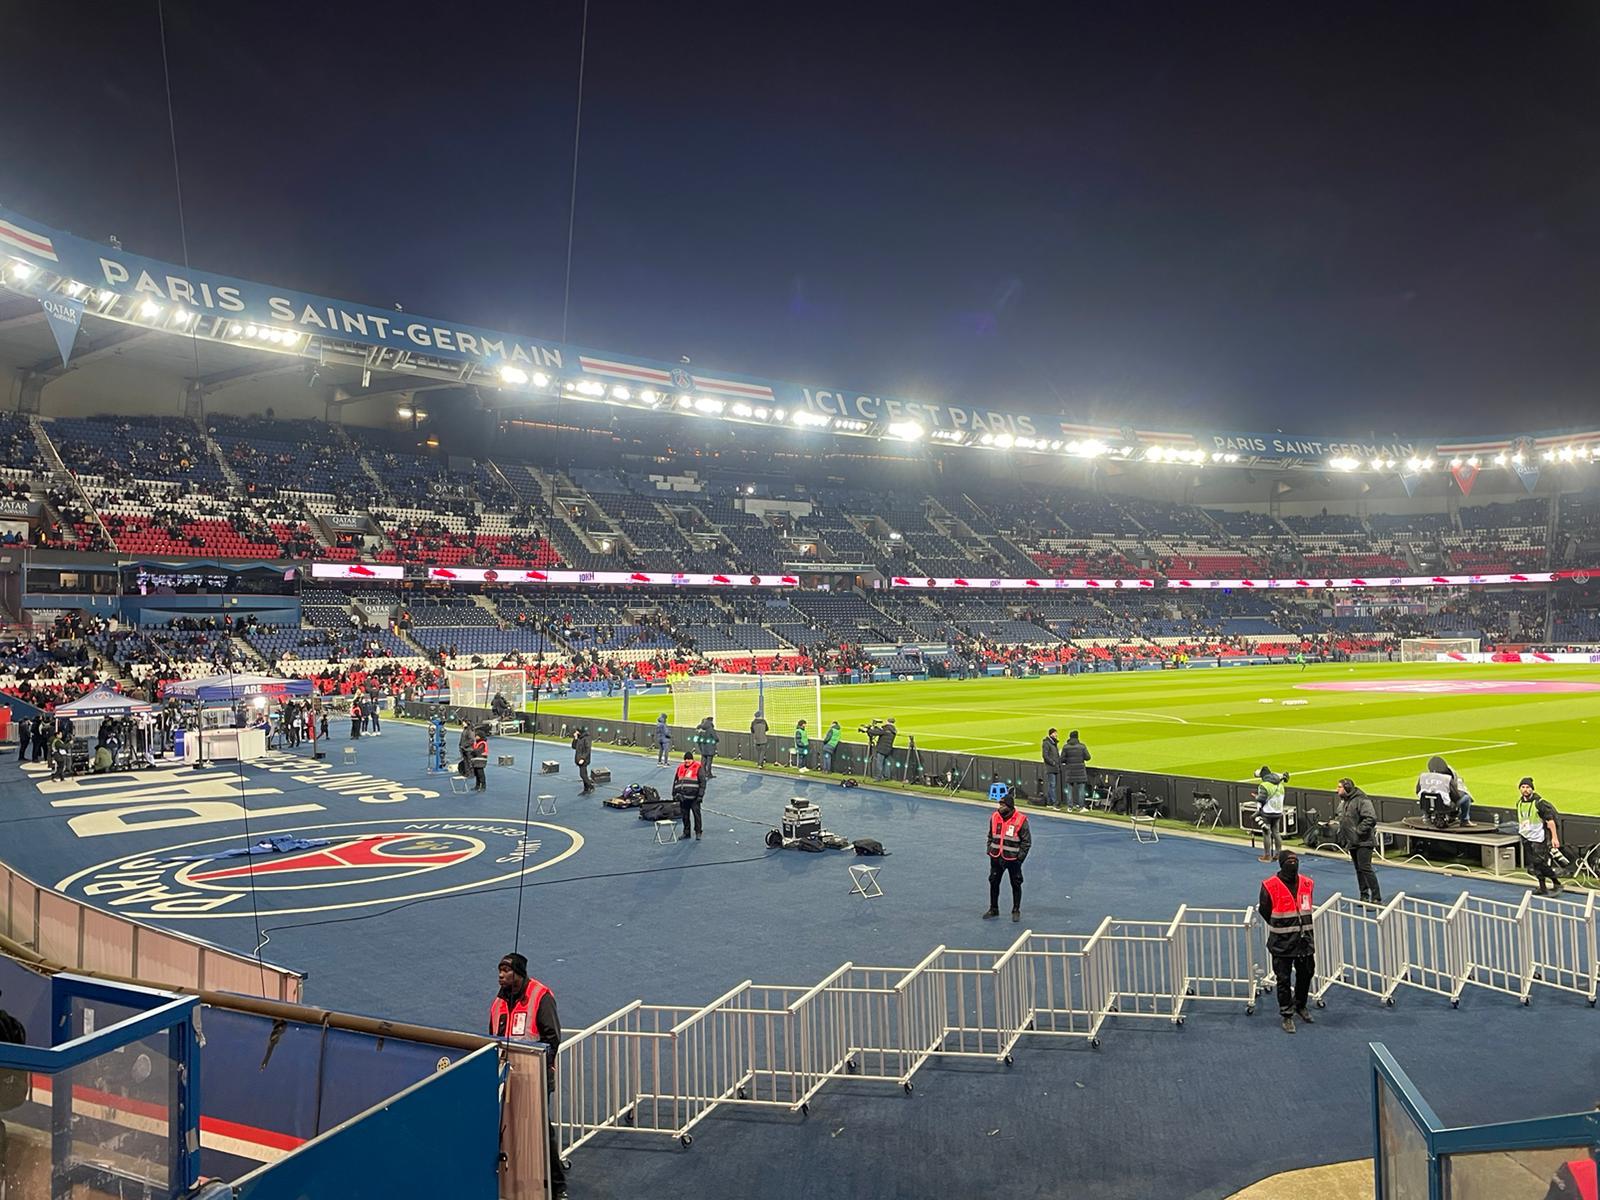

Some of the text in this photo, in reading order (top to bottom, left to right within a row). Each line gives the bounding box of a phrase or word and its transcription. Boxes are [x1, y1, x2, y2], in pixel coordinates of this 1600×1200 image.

[44, 300, 76, 320] QATAR
[99, 256, 563, 369] PARIS SAINT-GERMAIN
[802, 387, 1037, 437] ICI C'EST PARIS
[1213, 436, 1414, 457] PARIS SAINT-GERMAIN
[332, 516, 357, 527] QATAR
[364, 604, 390, 614] QATAR
[244, 685, 262, 695] ARE
